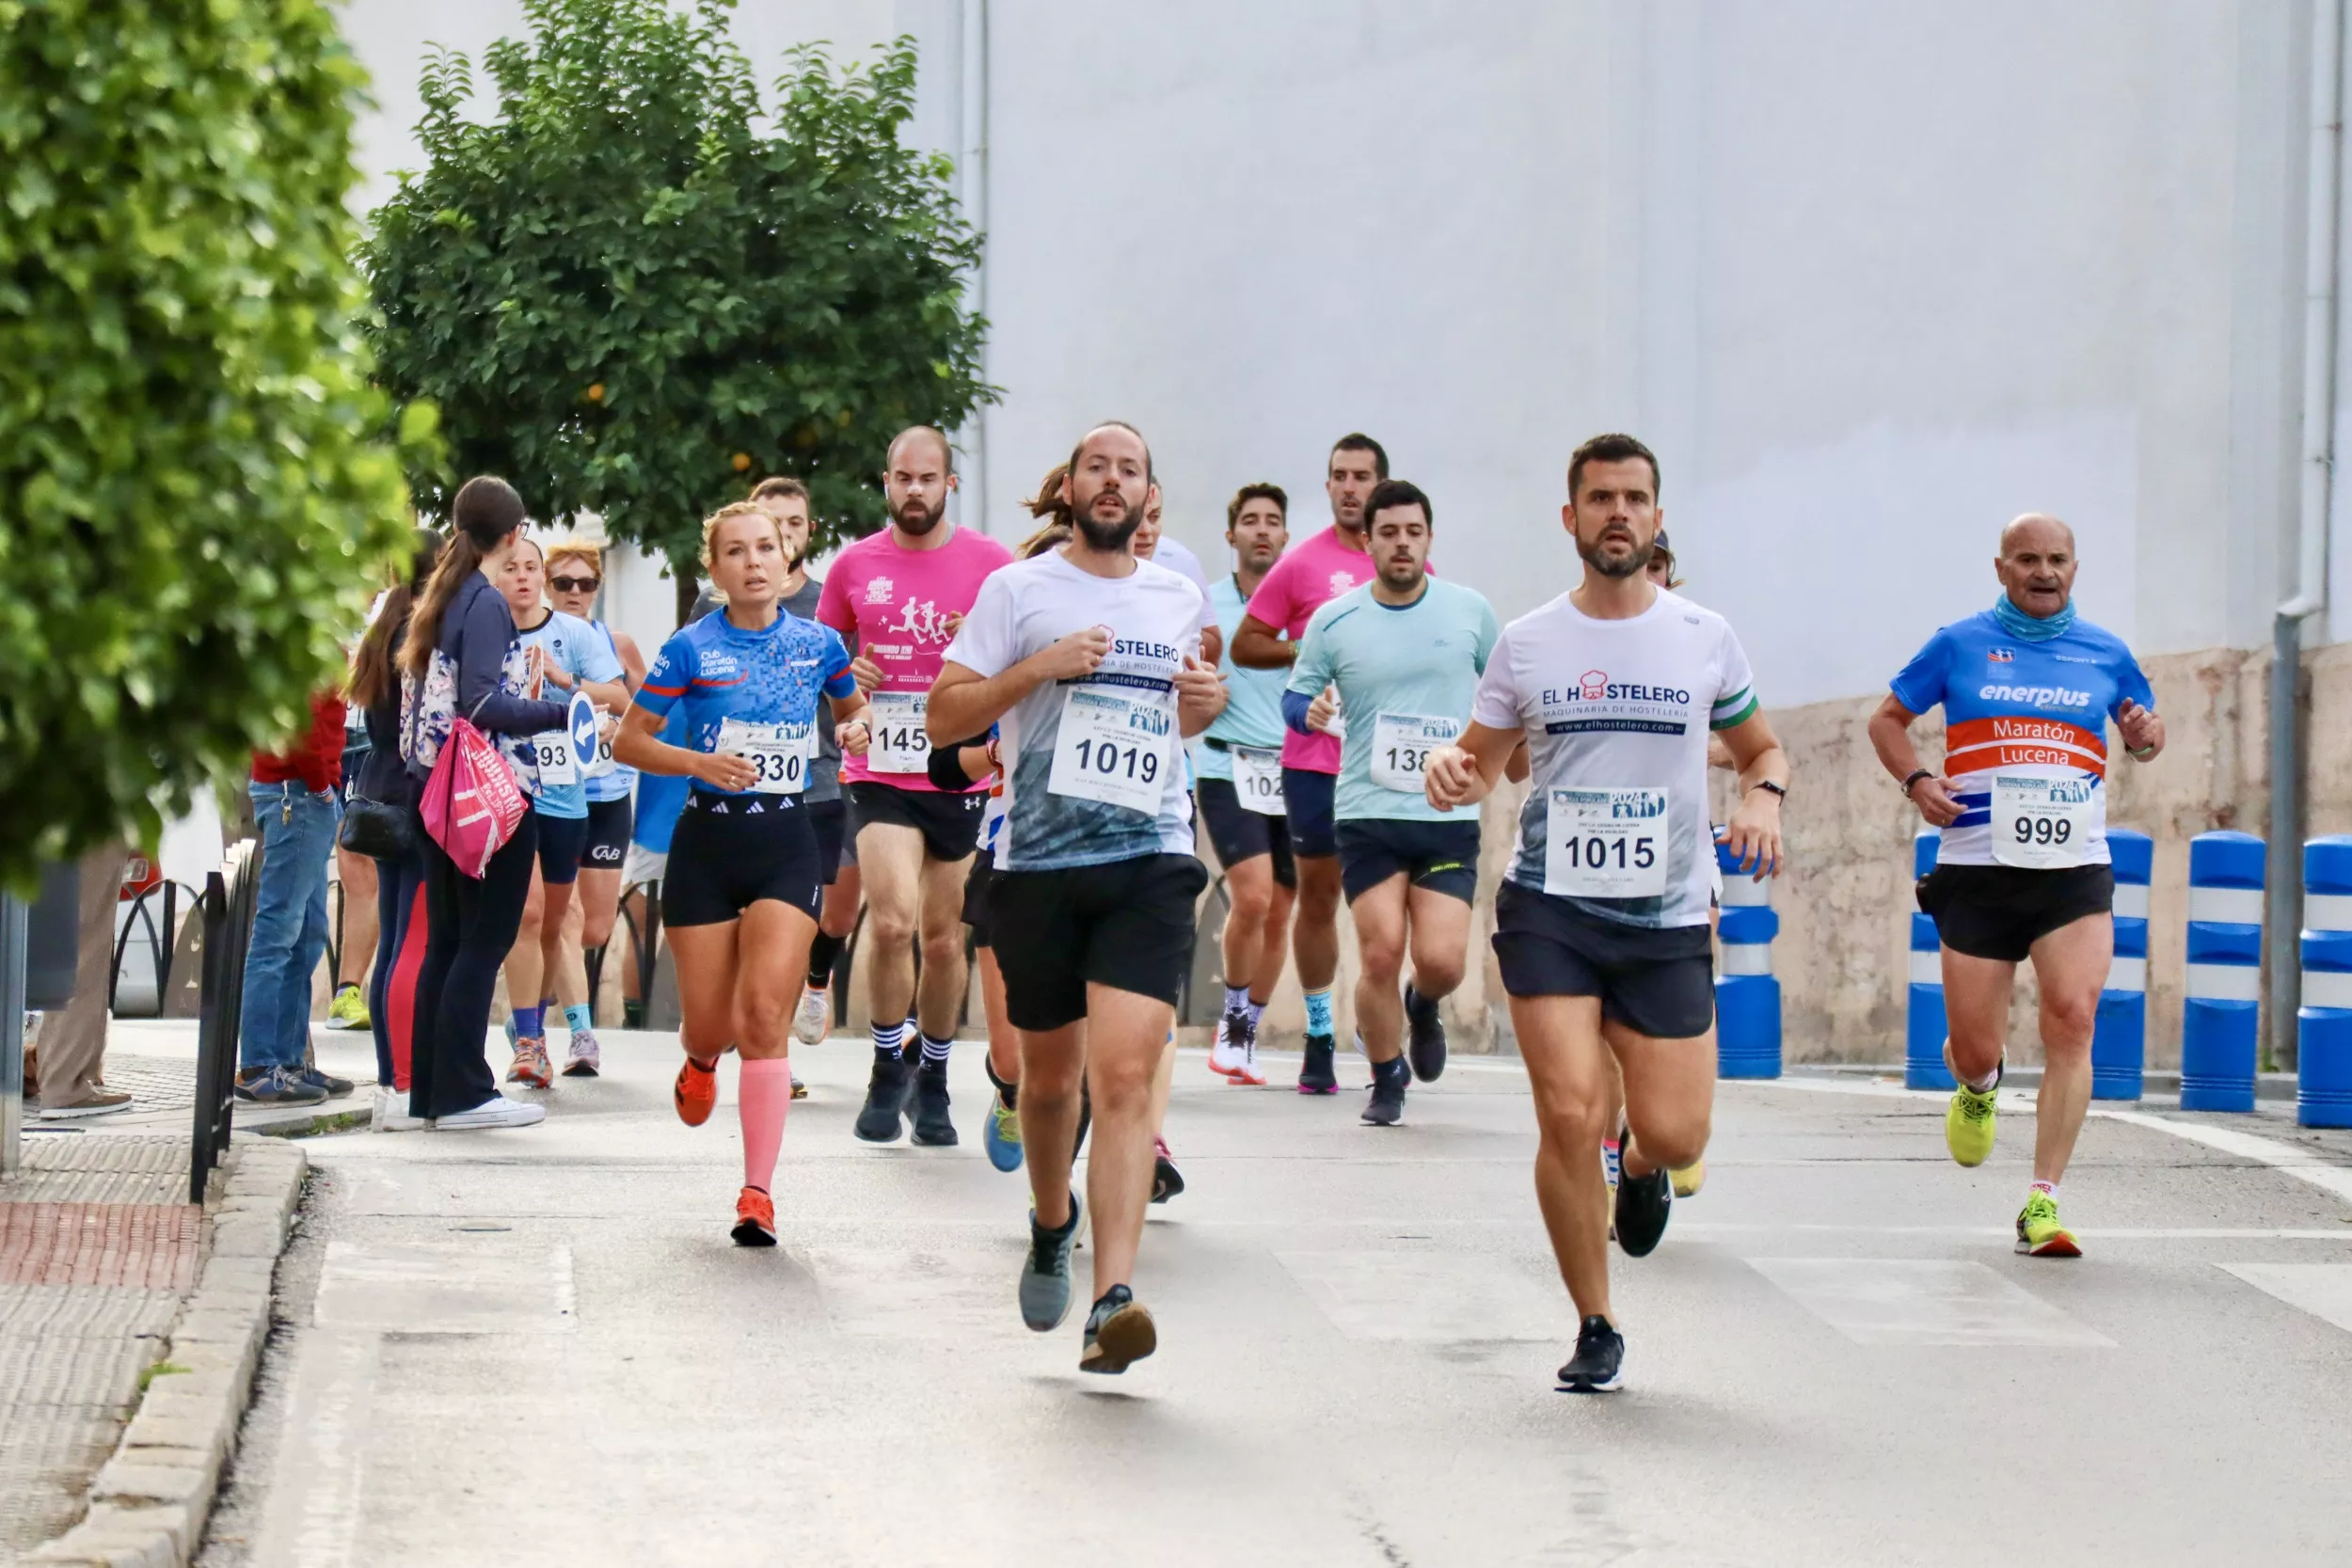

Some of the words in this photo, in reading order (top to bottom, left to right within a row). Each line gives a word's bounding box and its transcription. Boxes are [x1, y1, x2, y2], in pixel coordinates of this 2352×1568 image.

[700, 655, 738, 667] Maratón
[700, 664, 736, 676] Lucena
[1543, 689, 1562, 705] EL
[1979, 685, 2091, 707] enerplus
[1543, 705, 1608, 718] MAQUINARIA
[1612, 705, 1625, 714] DE
[1556, 719, 1675, 733] www.elhostelero.com
[1993, 720, 2075, 743] Maratón
[1075, 738, 1158, 784] 1019
[2000, 747, 2070, 766] Lucena
[735, 752, 800, 782] 330
[2014, 816, 2072, 845] 999
[1565, 835, 1655, 869] 1015
